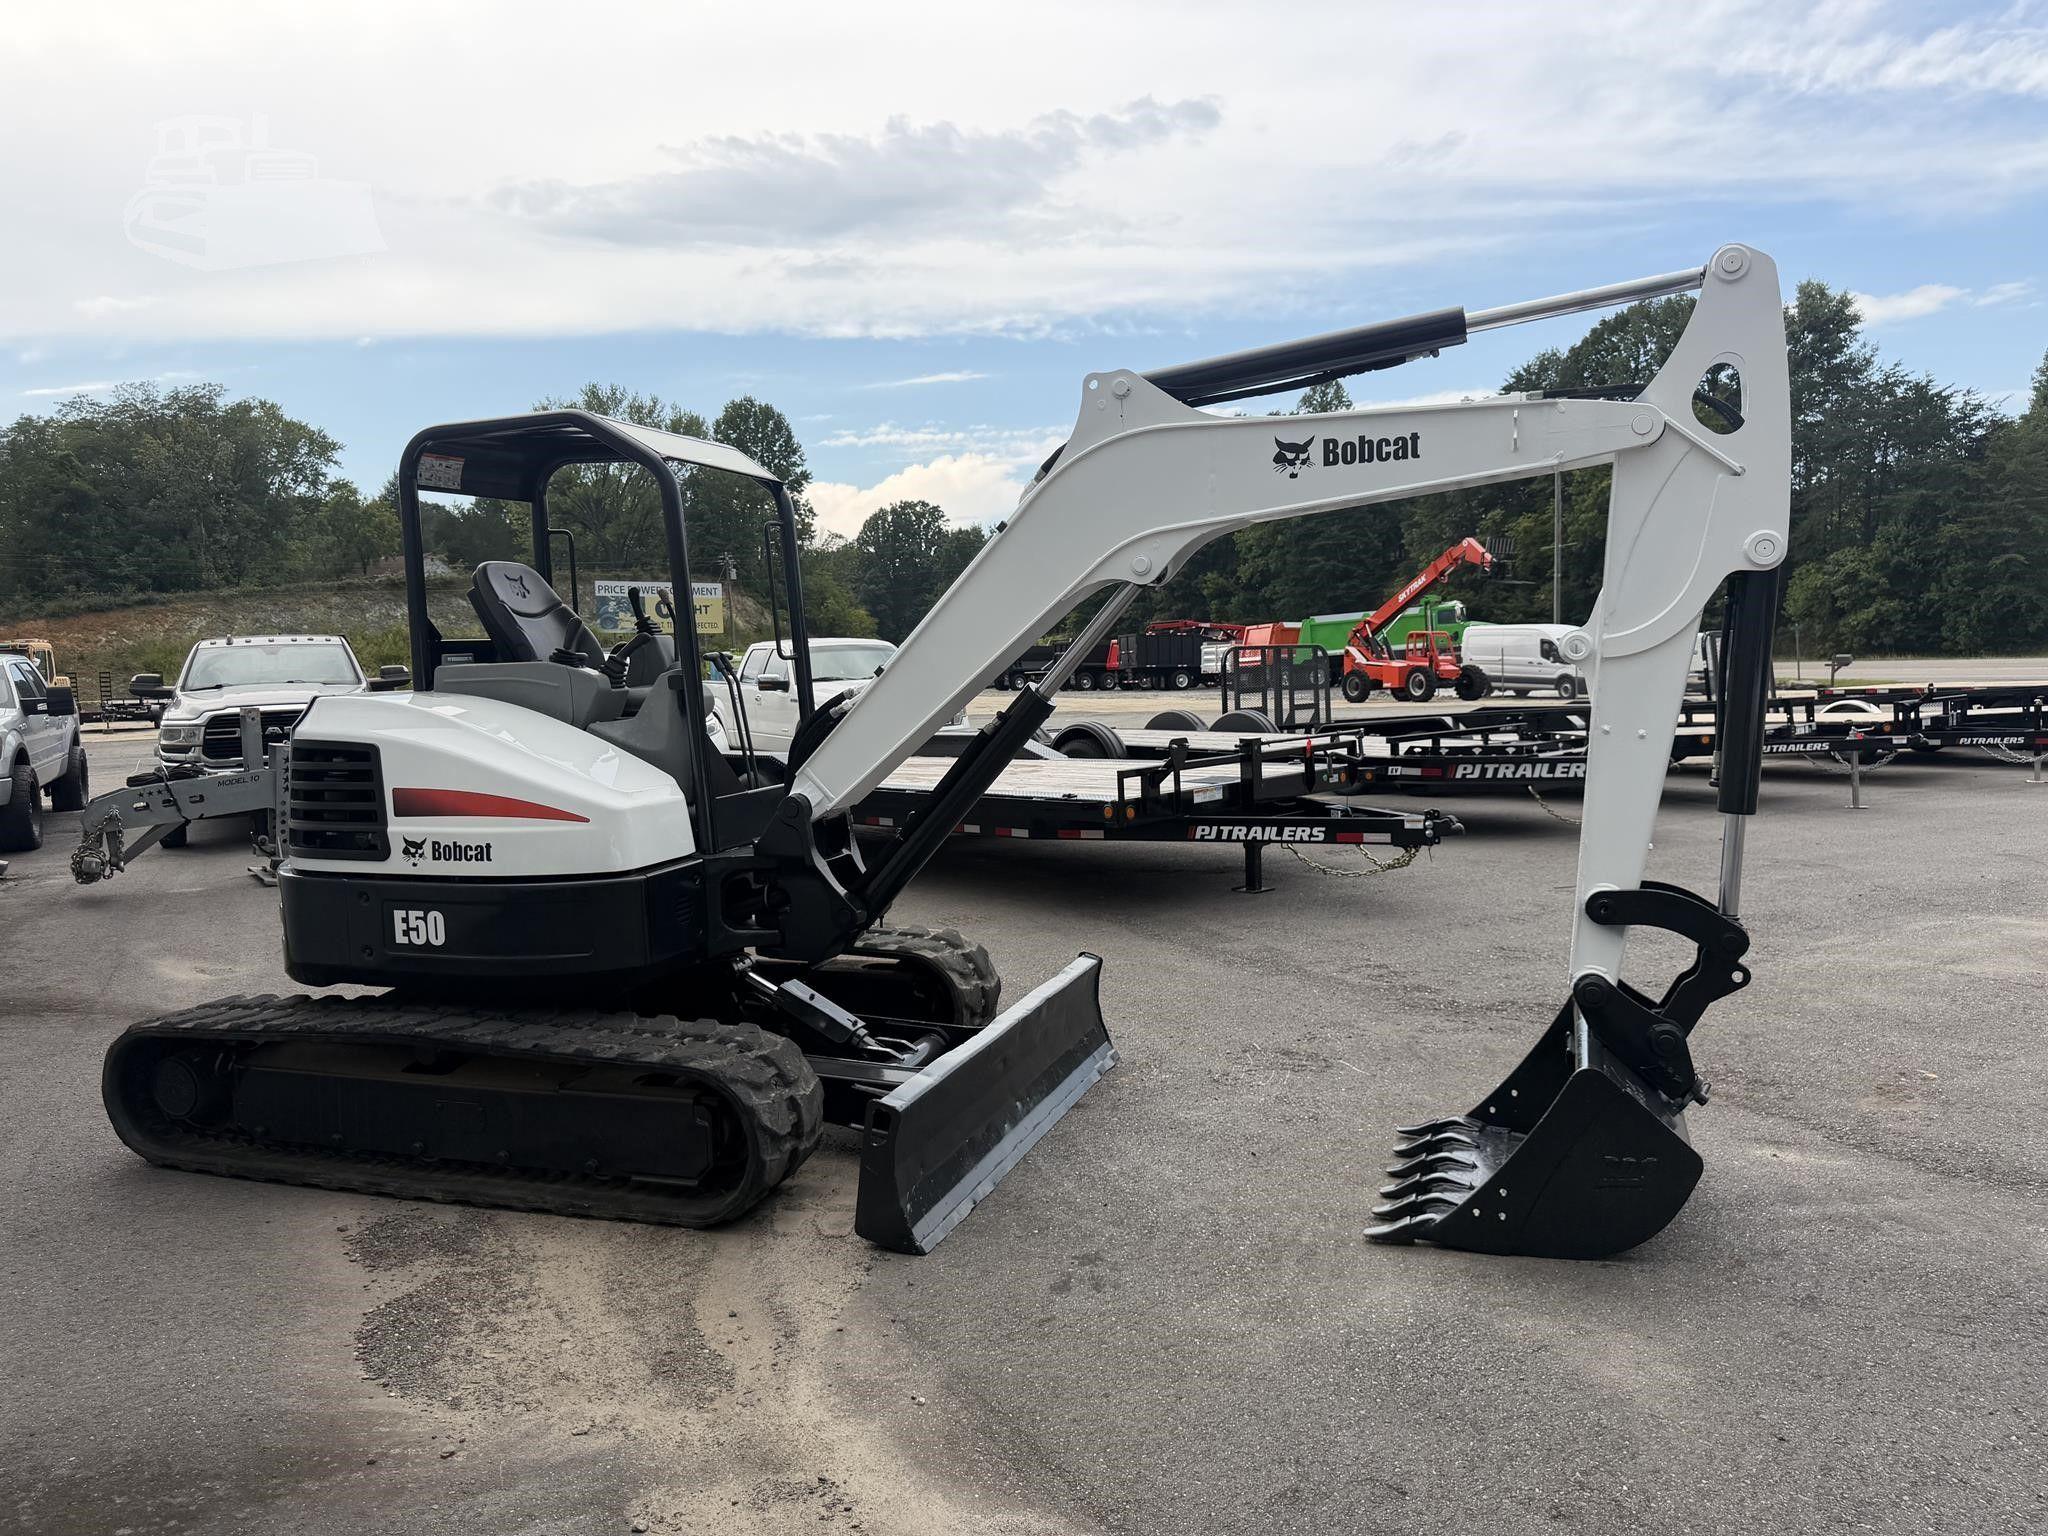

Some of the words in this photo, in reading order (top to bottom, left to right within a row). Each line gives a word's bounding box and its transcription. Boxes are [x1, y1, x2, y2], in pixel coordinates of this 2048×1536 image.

[1323, 432, 1420, 467] Bobcat
[597, 584, 626, 594] PRICE
[1484, 762, 1586, 779] TRAILER
[217, 777, 249, 787] MODEL
[431, 840, 492, 862] Bobcat
[393, 909, 446, 946] E50
